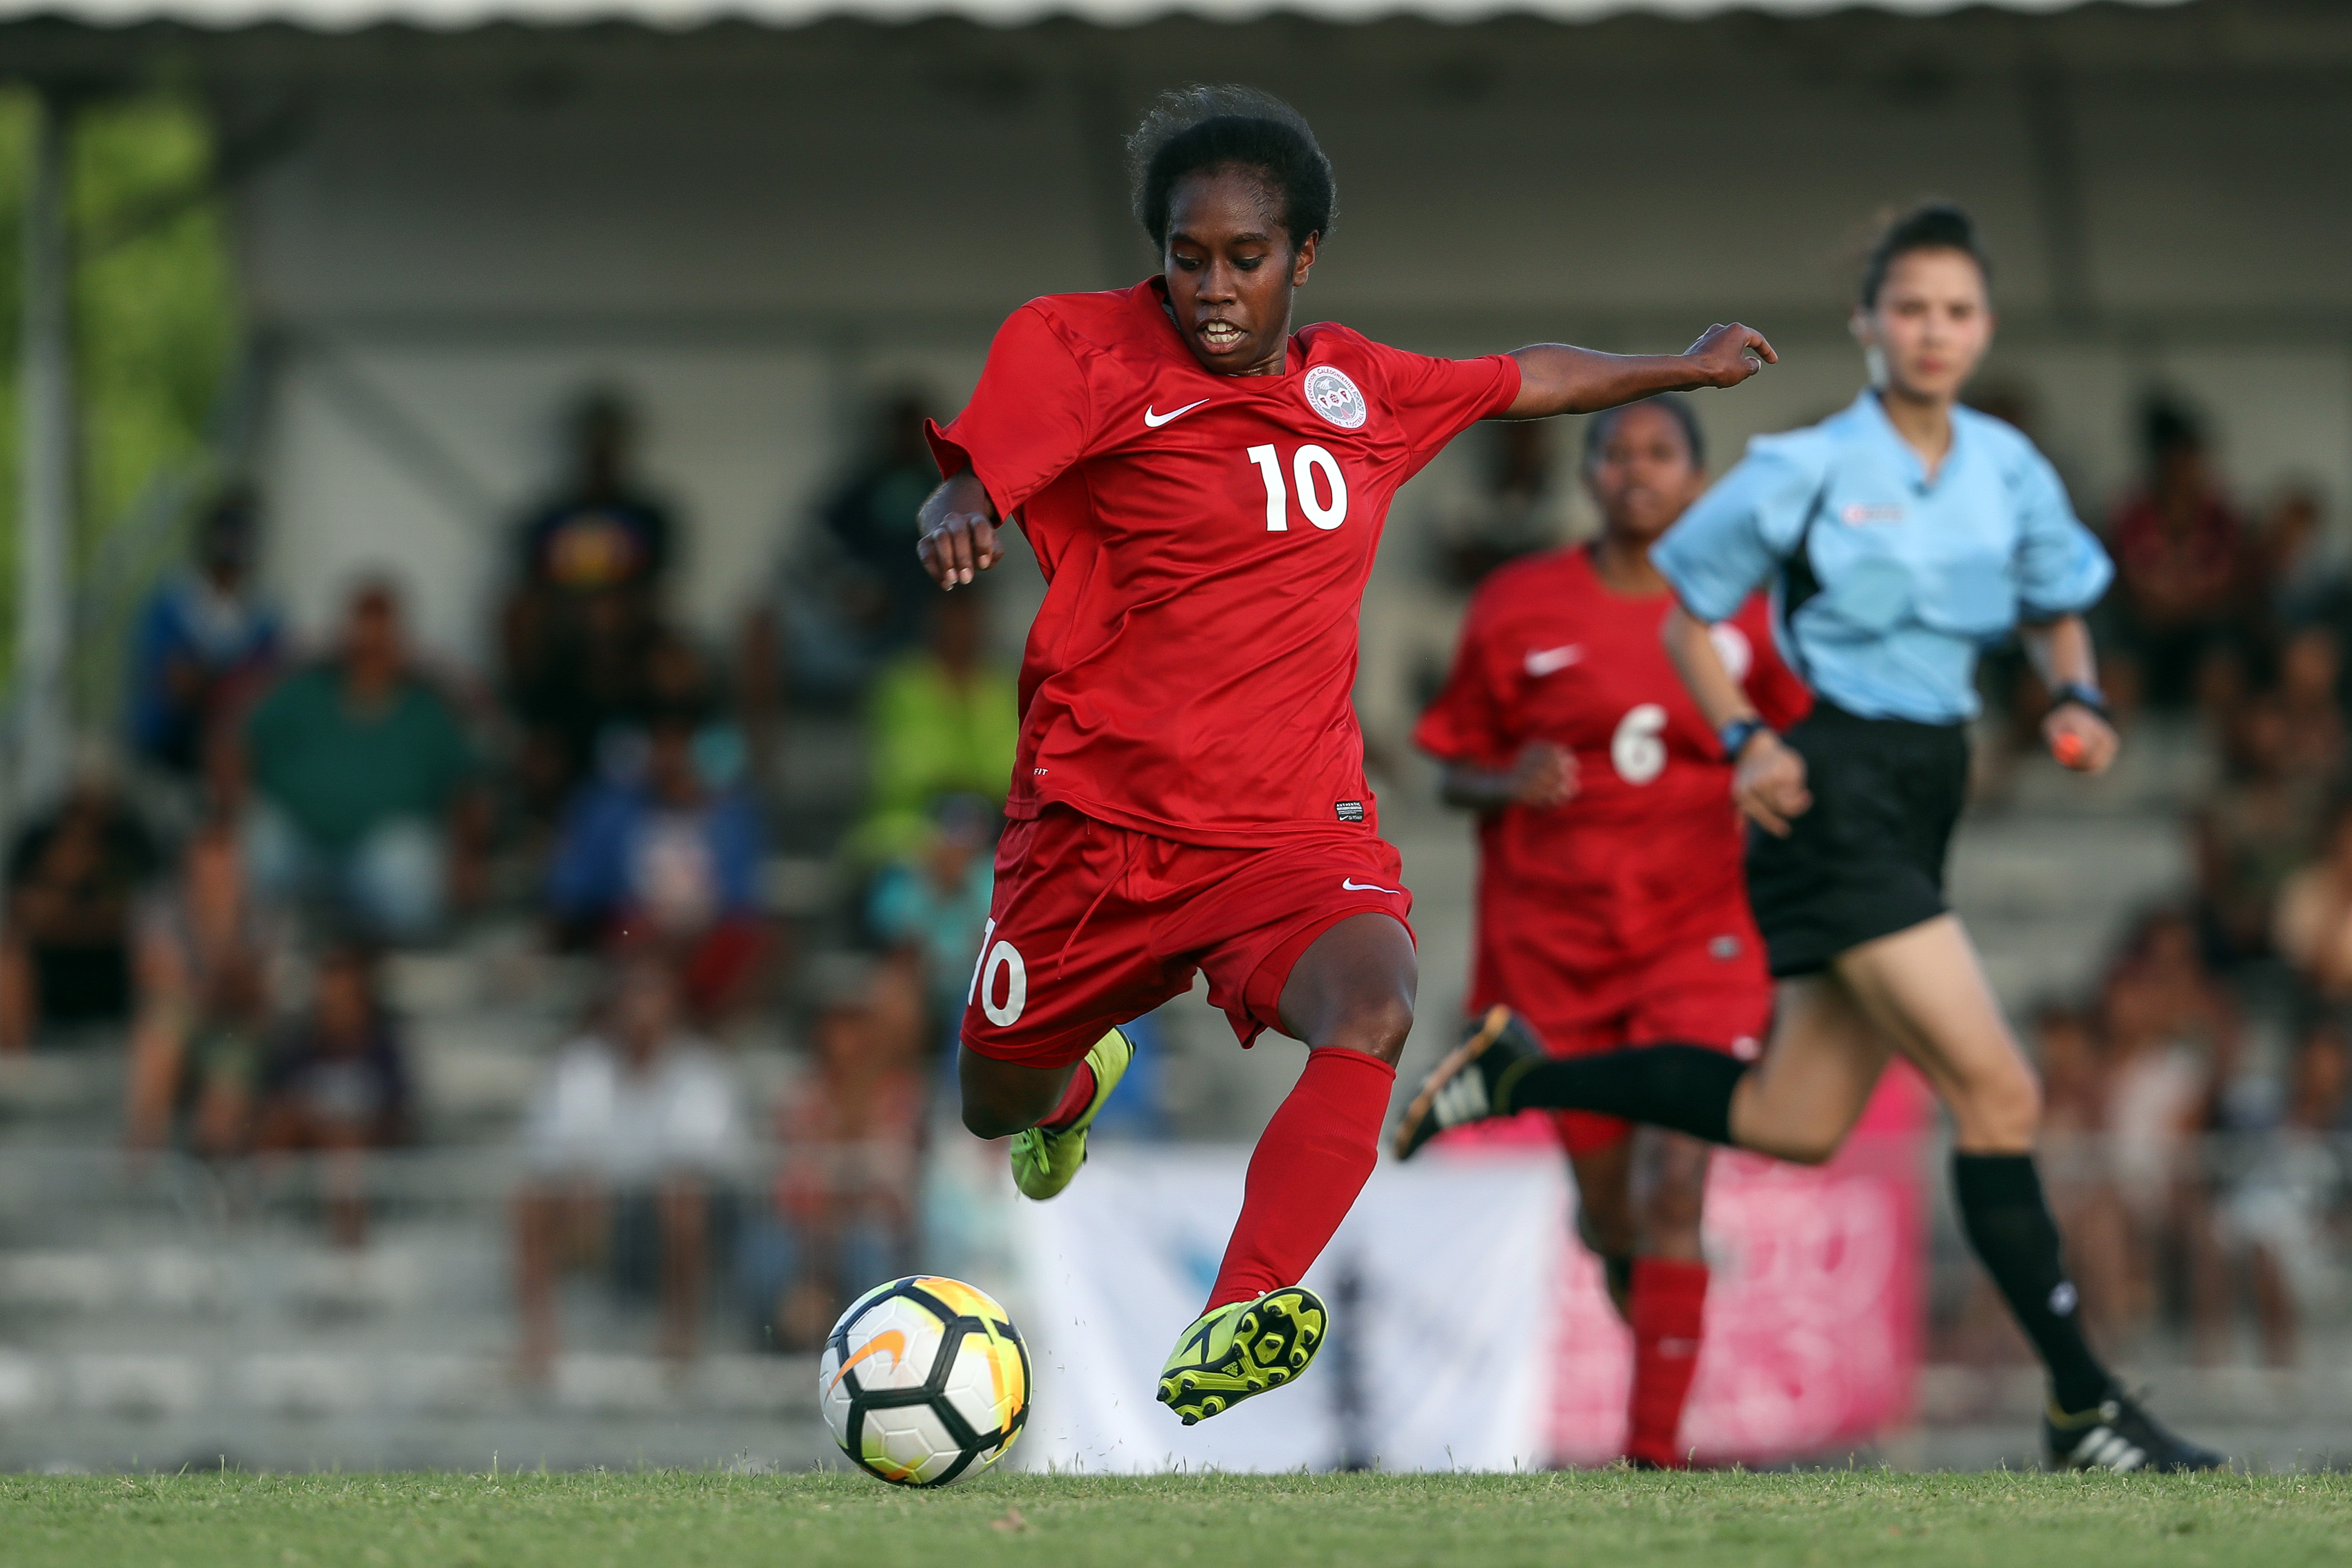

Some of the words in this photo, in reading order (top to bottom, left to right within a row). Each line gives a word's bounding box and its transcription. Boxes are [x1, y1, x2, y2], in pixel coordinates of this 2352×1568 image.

[1246, 443, 1348, 531] 10
[1610, 703, 1669, 785] 6
[967, 916, 1027, 1027] 10
